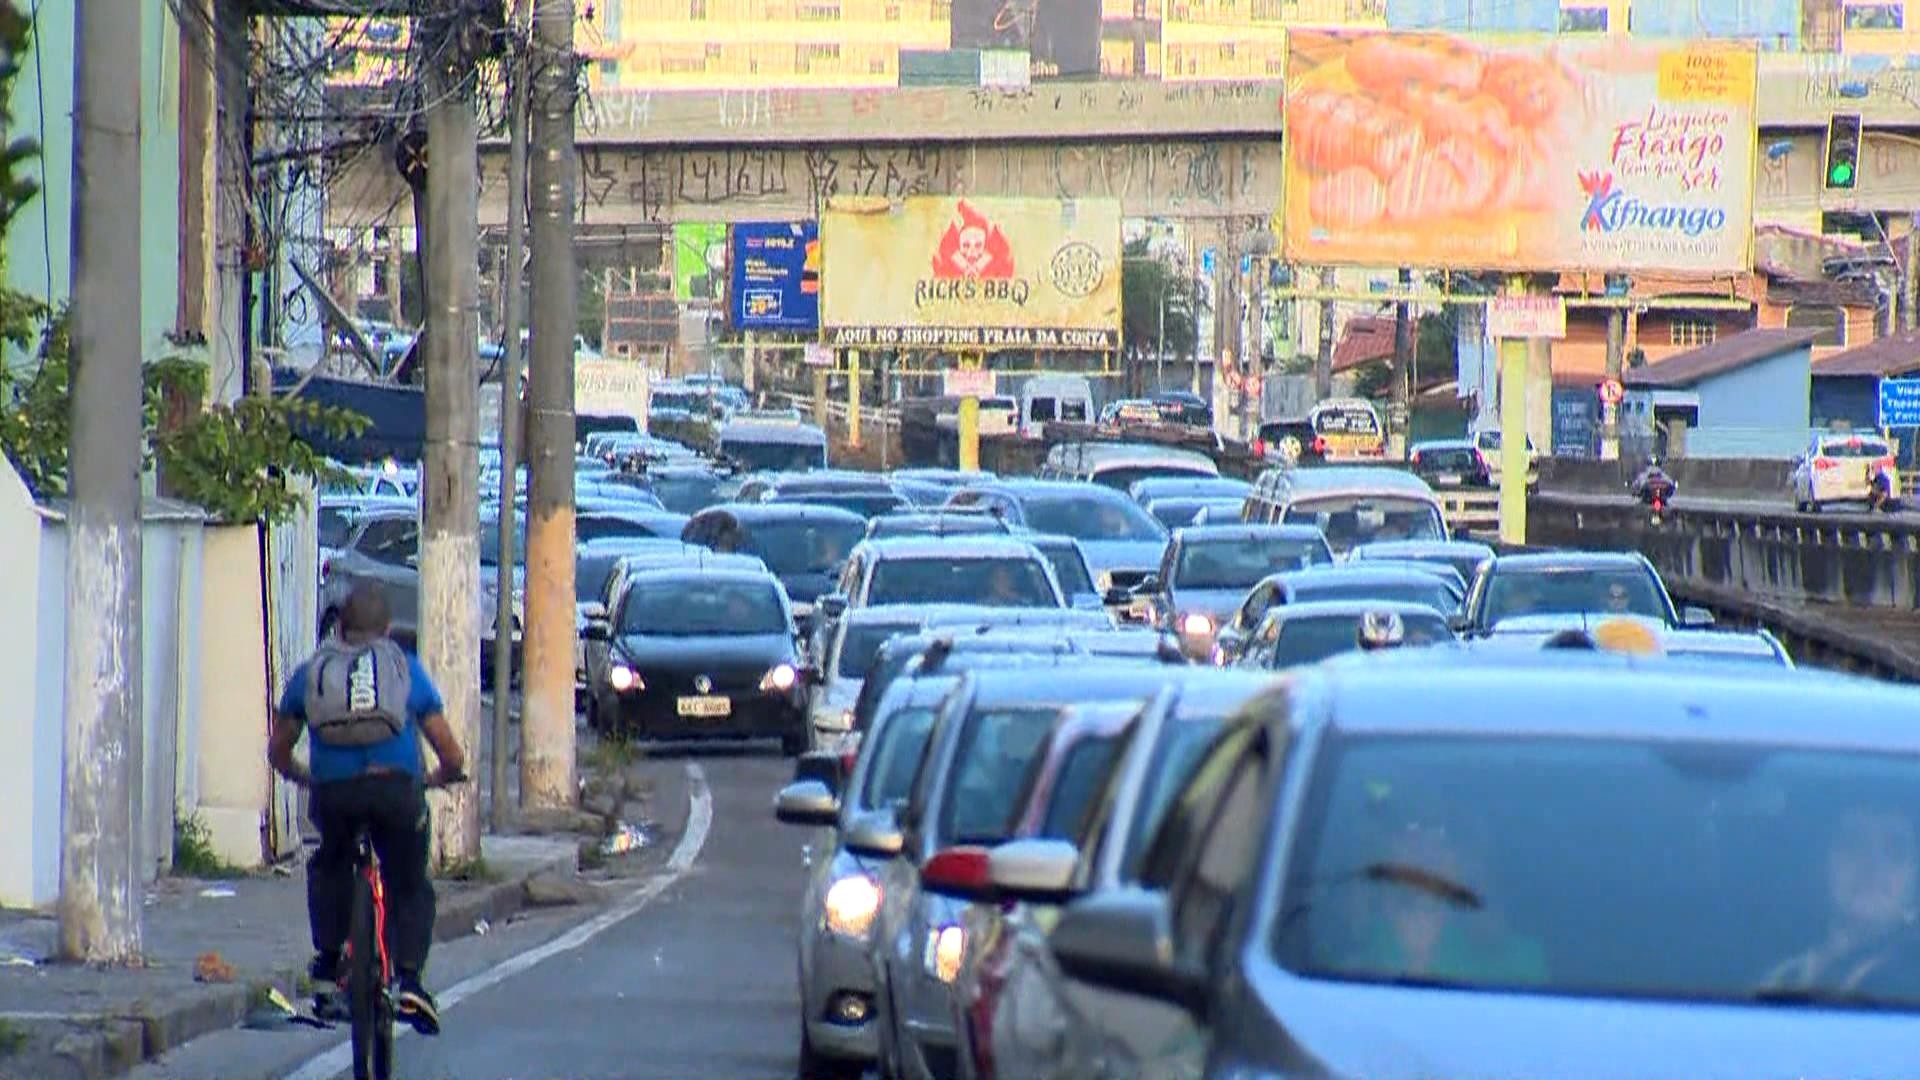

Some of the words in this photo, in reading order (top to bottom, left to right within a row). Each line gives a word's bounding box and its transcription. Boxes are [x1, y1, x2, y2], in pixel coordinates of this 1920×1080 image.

[1612, 121, 1724, 168] Frango
[914, 278, 977, 308] RICK'S
[983, 278, 1030, 307] BBQ
[835, 328, 871, 346] AQUI
[876, 328, 898, 342] NO
[901, 328, 979, 344] SHOPPING
[983, 329, 1032, 346] PRAIA
[1036, 329, 1058, 345] DA
[1061, 329, 1109, 346] COSTA
